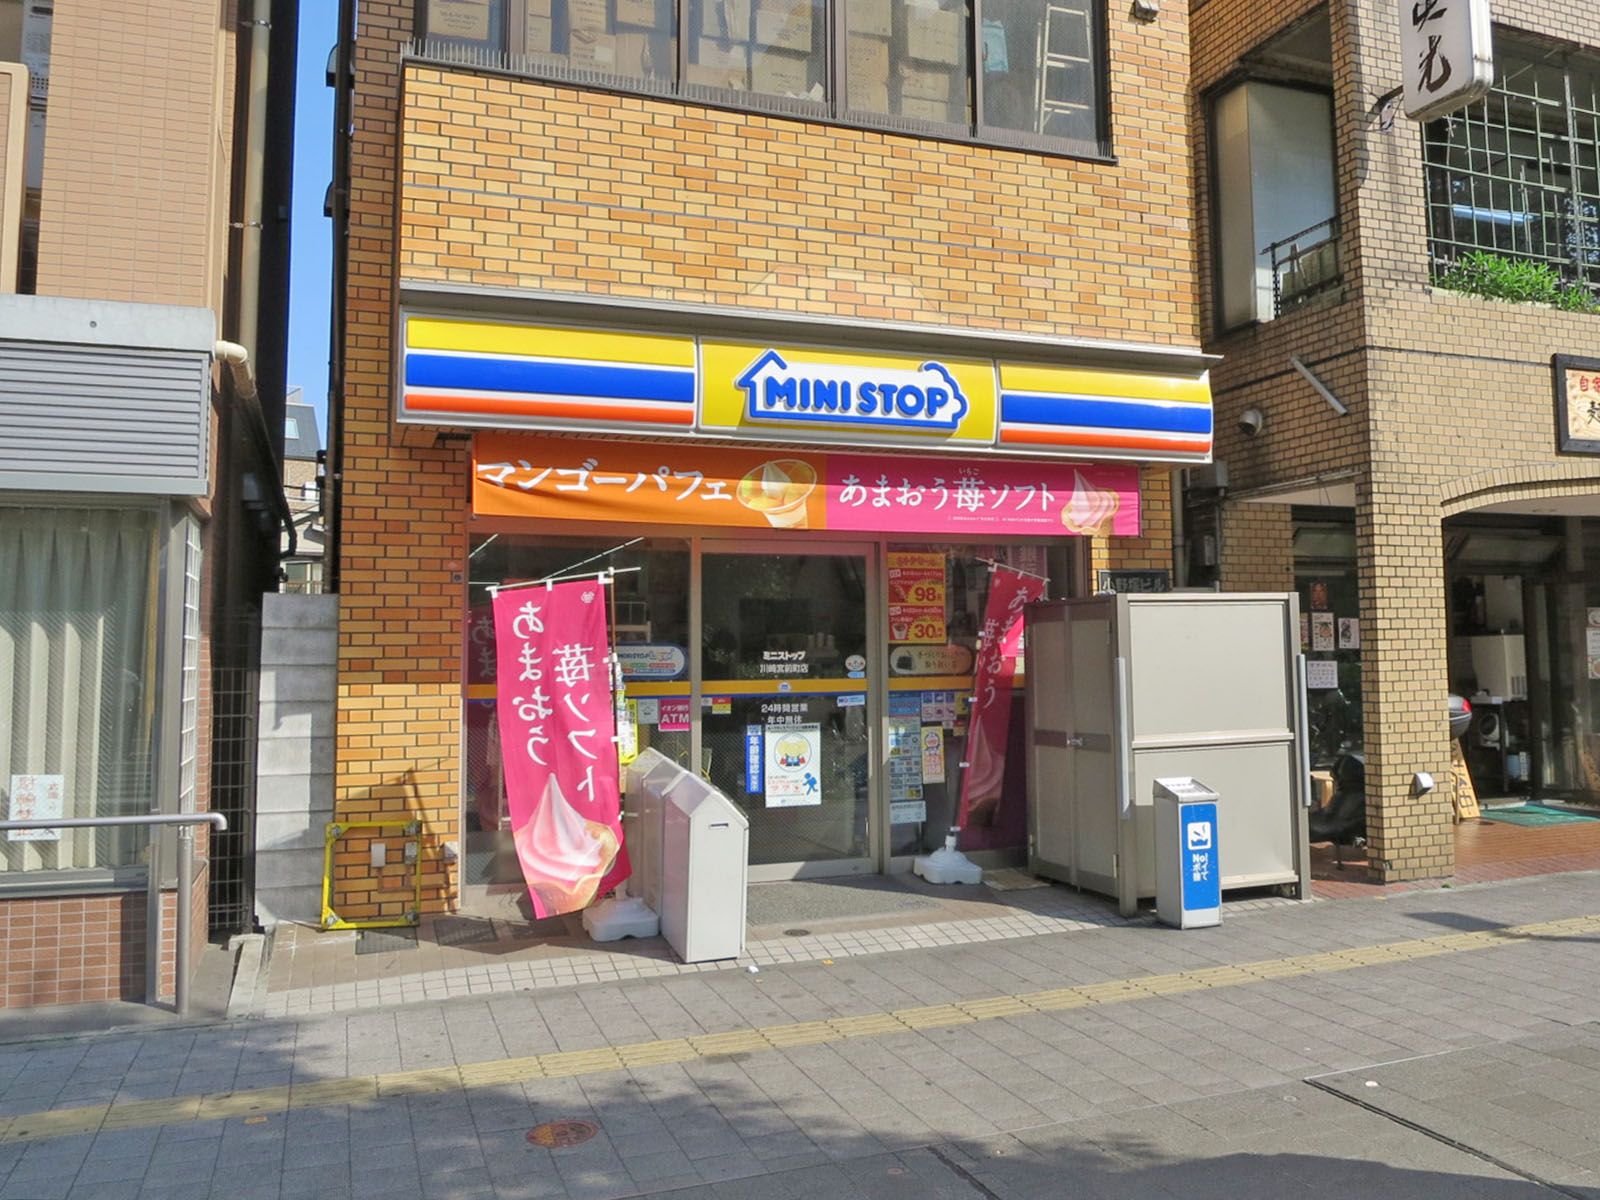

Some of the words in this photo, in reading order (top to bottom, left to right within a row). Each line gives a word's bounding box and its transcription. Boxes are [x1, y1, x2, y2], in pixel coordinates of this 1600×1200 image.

[476, 458, 733, 501] マンゴーパフェ
[839, 474, 1055, 512] あまおう苺ソフト
[763, 651, 806, 661] ミニストップ
[761, 704, 808, 713] 24時間営業
[661, 714, 689, 723] ATM
